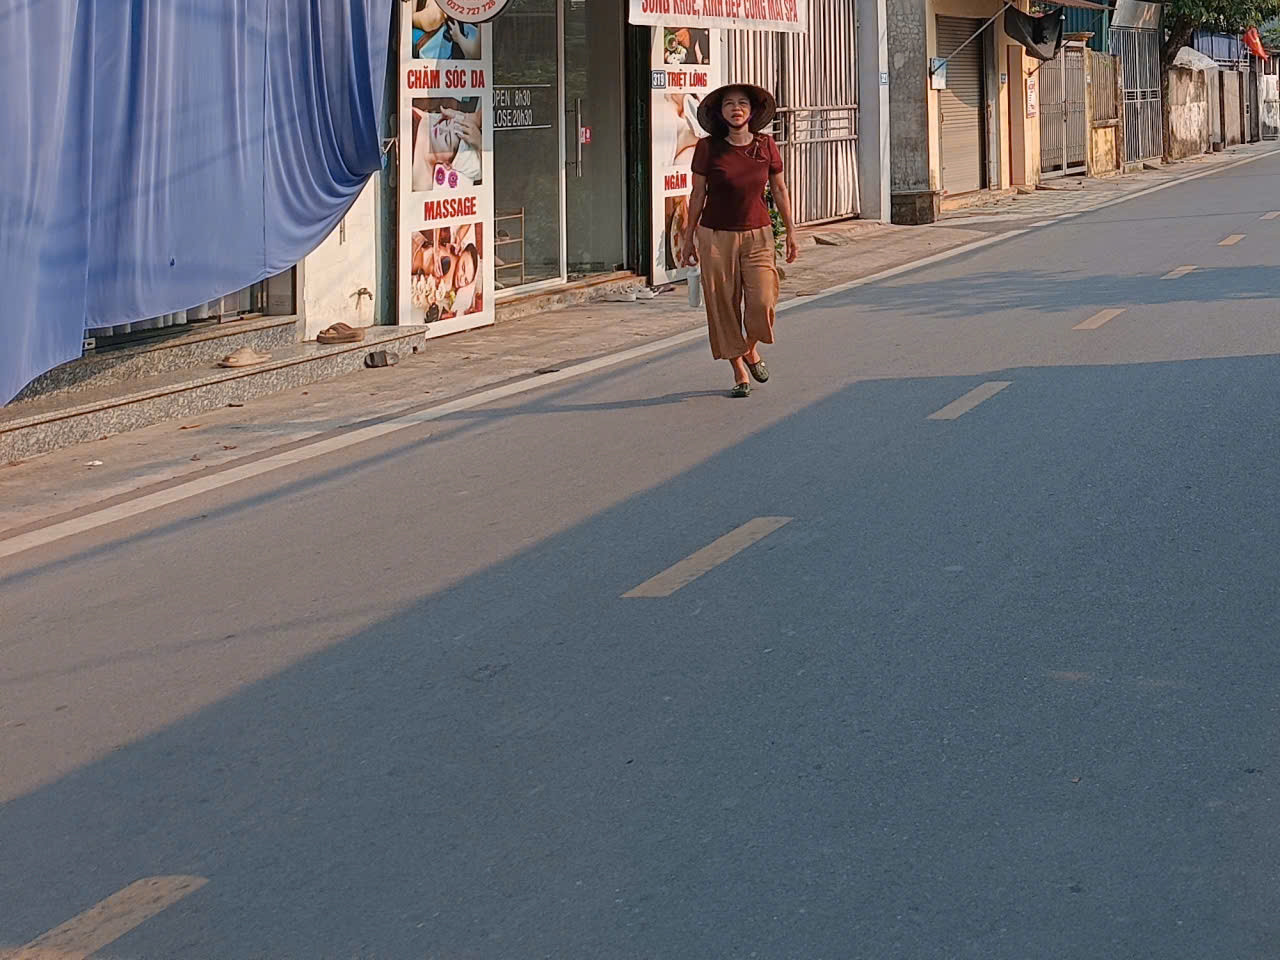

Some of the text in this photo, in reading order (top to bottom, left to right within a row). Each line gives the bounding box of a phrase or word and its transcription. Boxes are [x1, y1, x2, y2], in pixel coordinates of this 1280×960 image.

[446, 0, 465, 14] 0372
[466, 7, 480, 15] 727
[407, 65, 485, 89] CHĂM SÓC DA
[515, 89, 531, 106] 8h30
[494, 109, 532, 127] LOSE 20h30
[424, 196, 477, 221] MASSAGE
